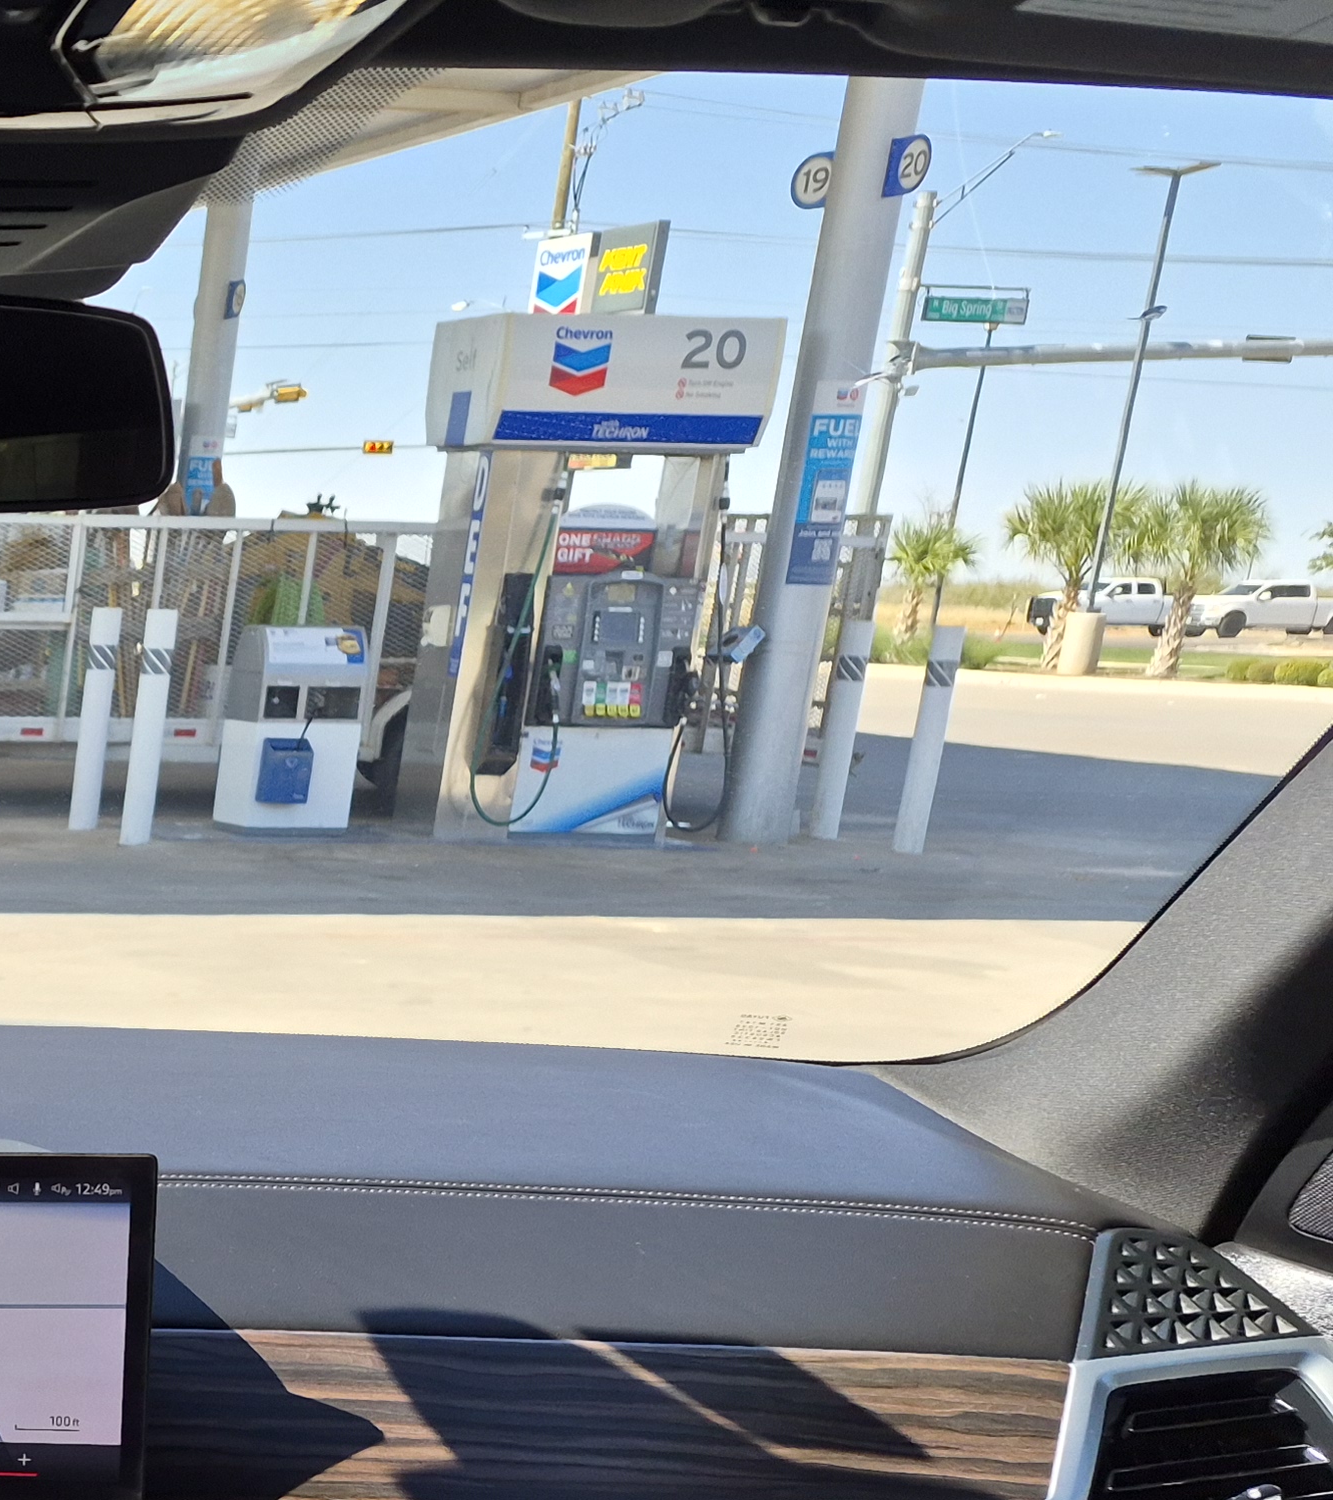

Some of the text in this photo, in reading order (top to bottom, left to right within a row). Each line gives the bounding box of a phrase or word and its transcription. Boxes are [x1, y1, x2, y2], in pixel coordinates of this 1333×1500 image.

[899, 150, 928, 179] 20
[802, 166, 830, 195] 19
[540, 247, 585, 267] Chevron
[941, 300, 958, 319] Big
[959, 300, 992, 320] Spring
[556, 326, 613, 340] Chevron
[680, 329, 748, 370] 20
[591, 423, 649, 440] TECHRON
[827, 438, 852, 448] WITH
[559, 532, 592, 547] ONE
[798, 529, 816, 537] Join
[558, 547, 594, 564] GIFT
[75, 1183, 123, 1196] 12:49pm
[49, 1416, 80, 1428] 100 ft
